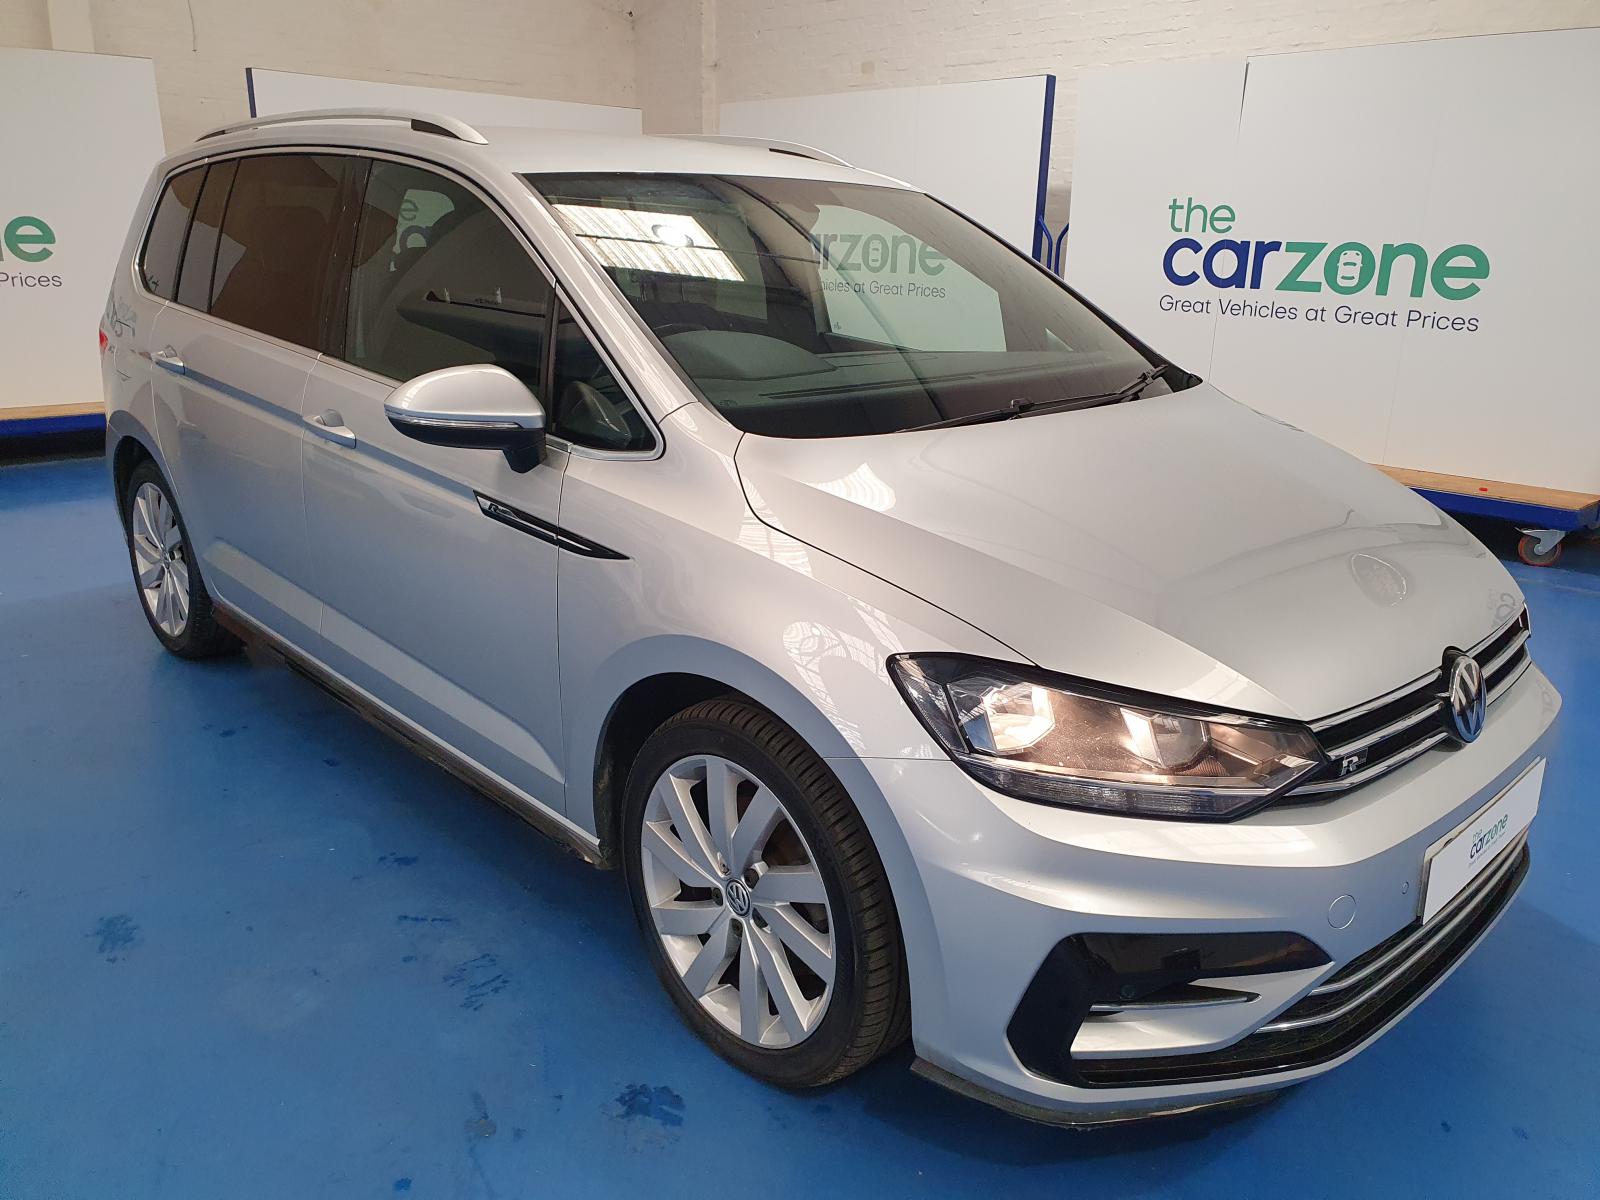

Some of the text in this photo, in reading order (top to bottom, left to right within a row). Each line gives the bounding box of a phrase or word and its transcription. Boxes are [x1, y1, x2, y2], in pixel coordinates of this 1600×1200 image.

[1168, 197, 1236, 233] the
[0, 215, 56, 263] e
[853, 282, 865, 294] at
[869, 280, 904, 296] Great
[907, 282, 946, 299] Prices
[1163, 238, 1490, 300] carzone
[1159, 294, 1480, 333] Great Vehicles at Great Prices
[1469, 813, 1509, 859] carzone
